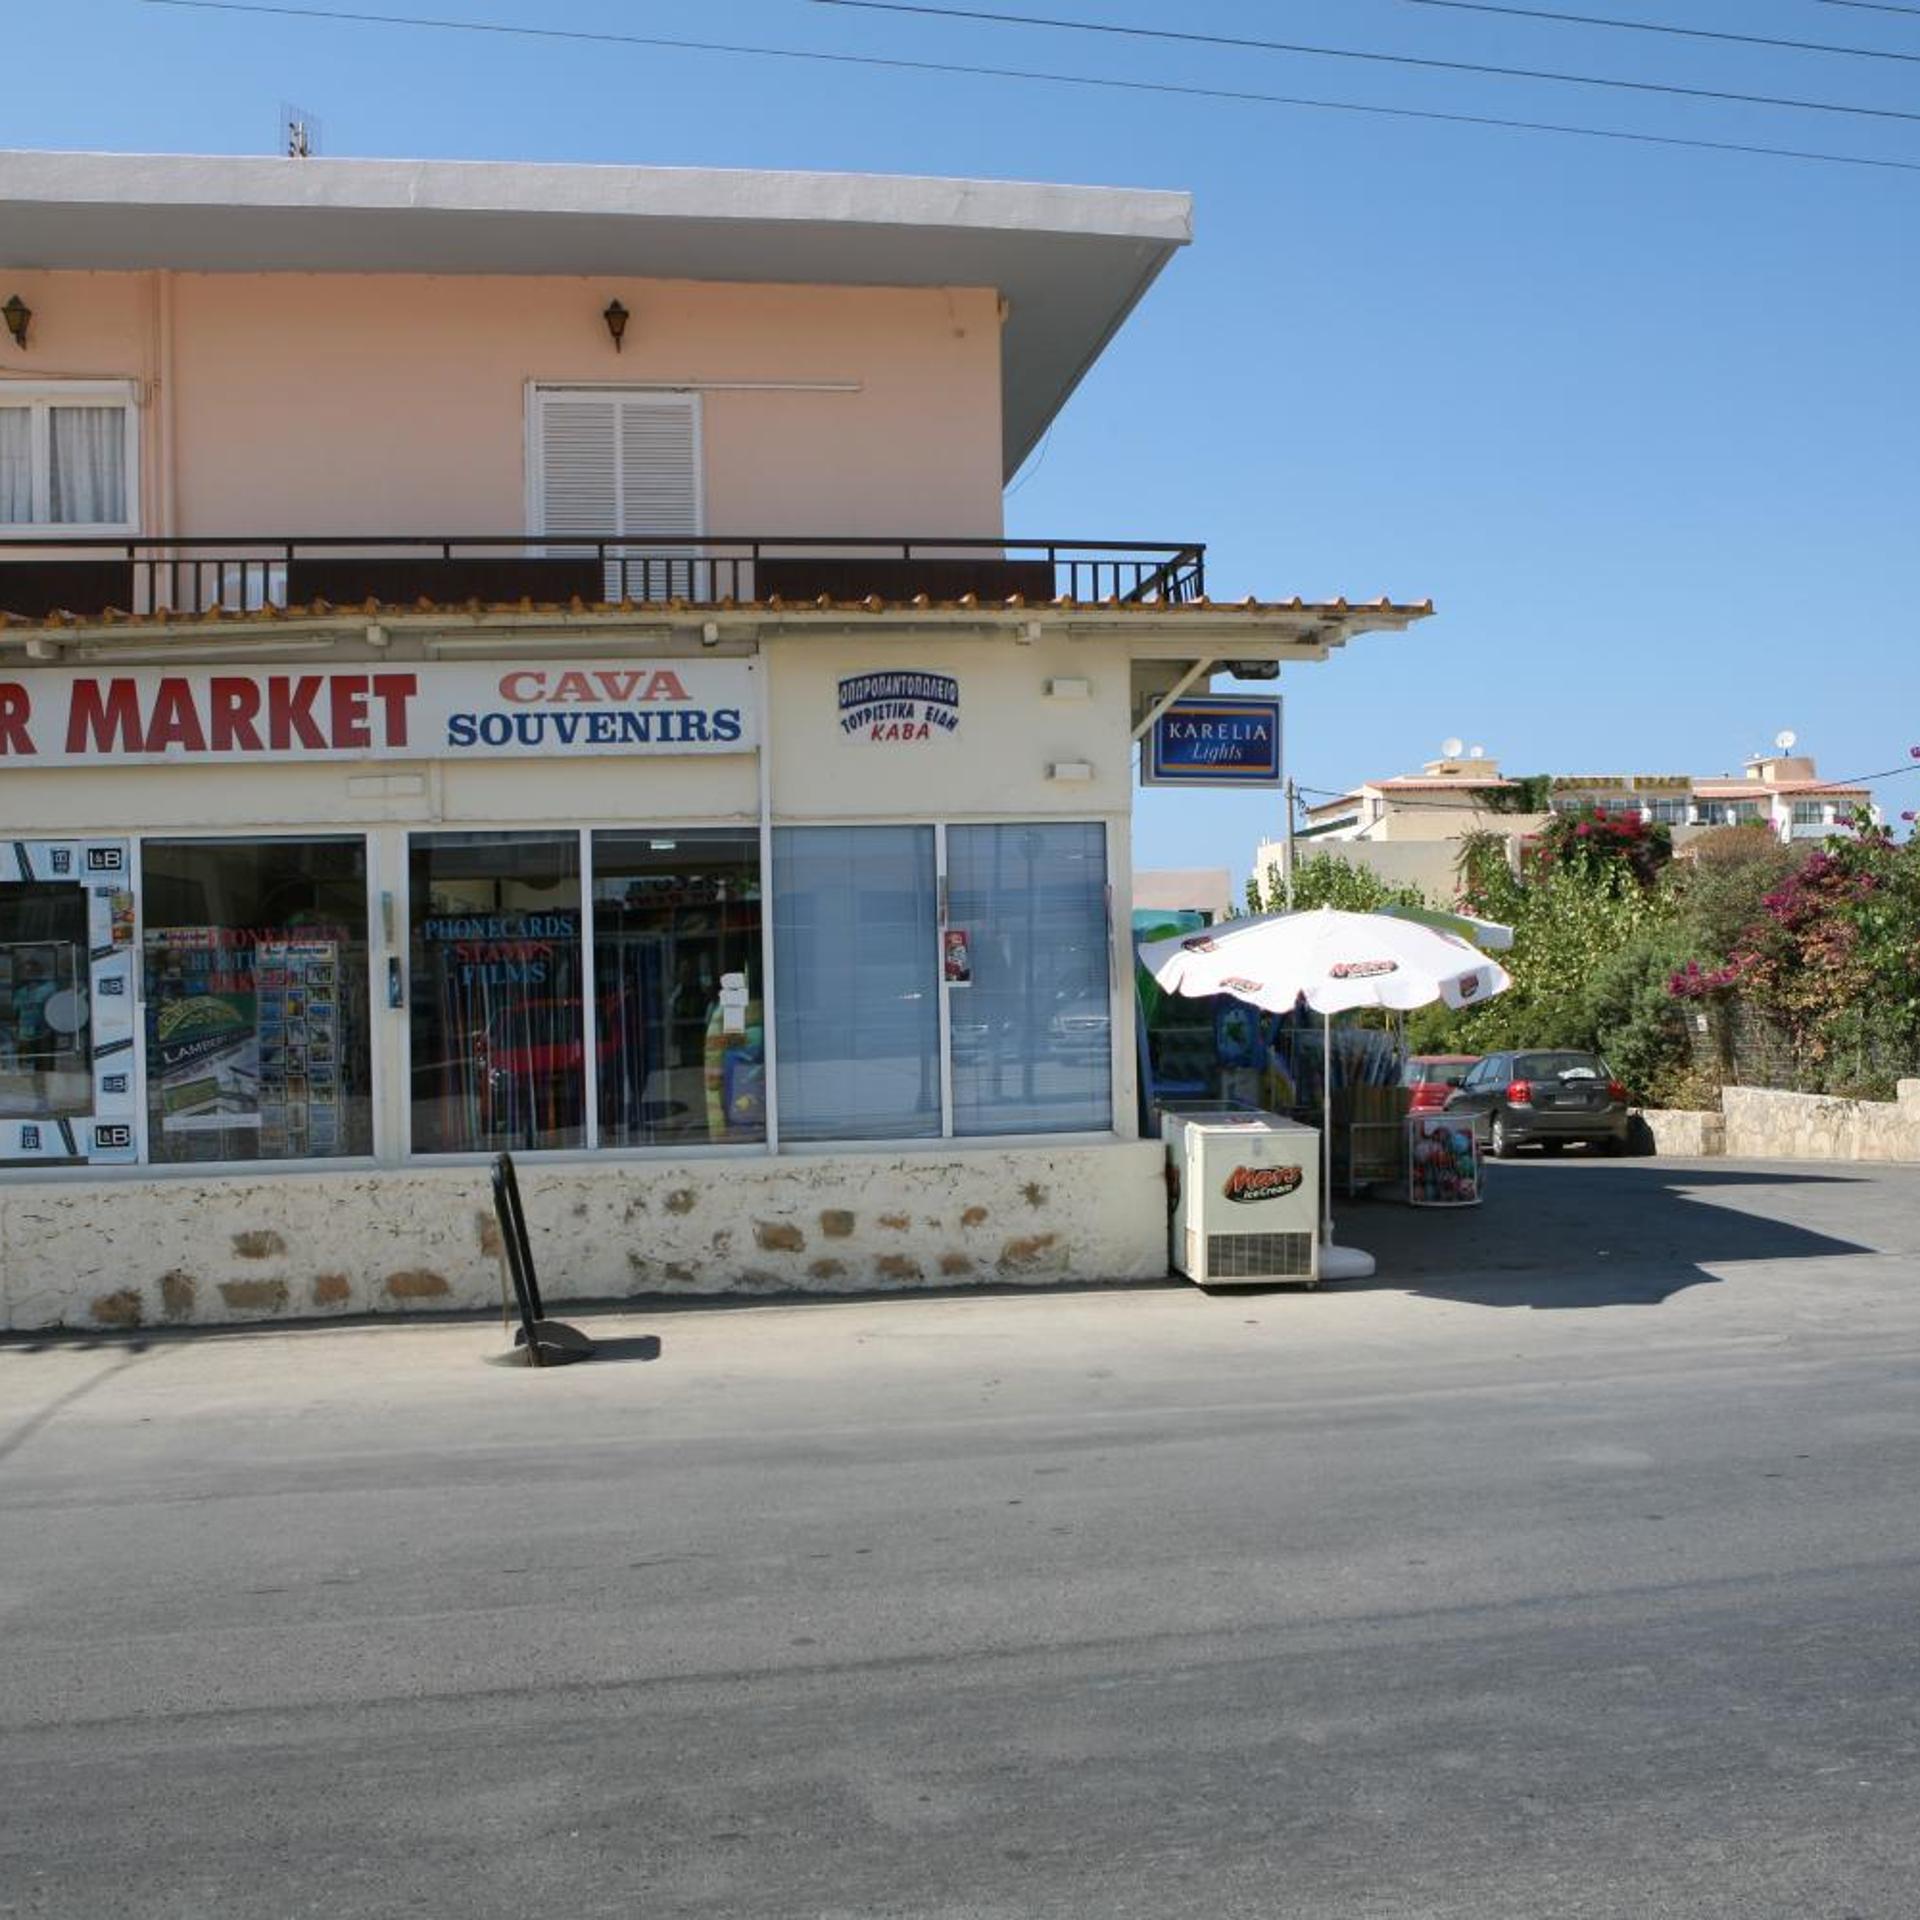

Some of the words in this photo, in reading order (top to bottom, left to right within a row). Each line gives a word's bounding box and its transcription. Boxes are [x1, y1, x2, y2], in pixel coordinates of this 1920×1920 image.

[499, 670, 692, 703] CAVA
[65, 673, 417, 754] MARKET
[448, 709, 742, 747] SOUVENIRS
[1169, 722, 1268, 740] KARELIA
[1193, 742, 1242, 763] Lights
[426, 917, 573, 939] PHONECARDS
